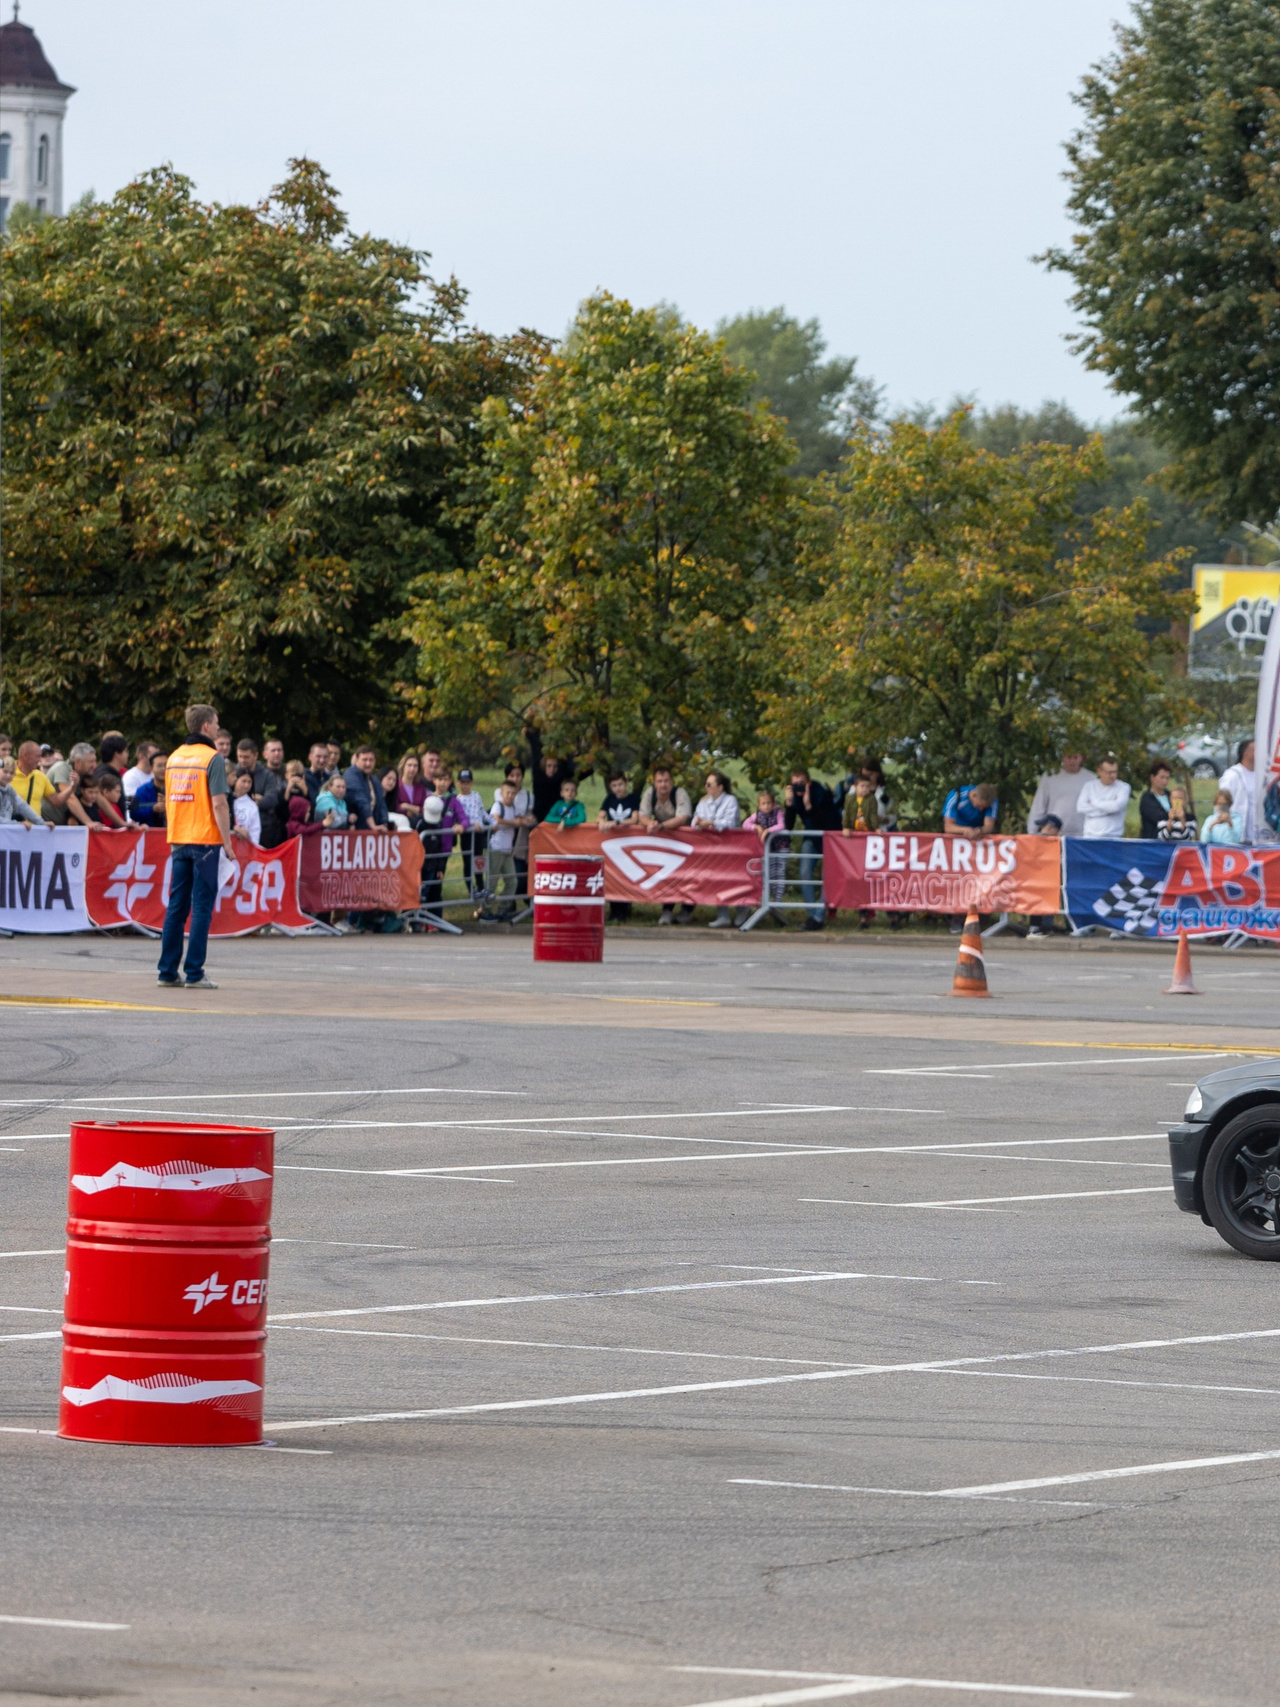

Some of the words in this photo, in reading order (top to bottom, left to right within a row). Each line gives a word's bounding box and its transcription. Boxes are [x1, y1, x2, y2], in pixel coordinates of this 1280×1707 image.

[320, 835, 402, 870] BELARUS
[864, 835, 1017, 874] BELARUS
[320, 871, 401, 909] TRACTORS
[863, 871, 1018, 909] TRACTORS
